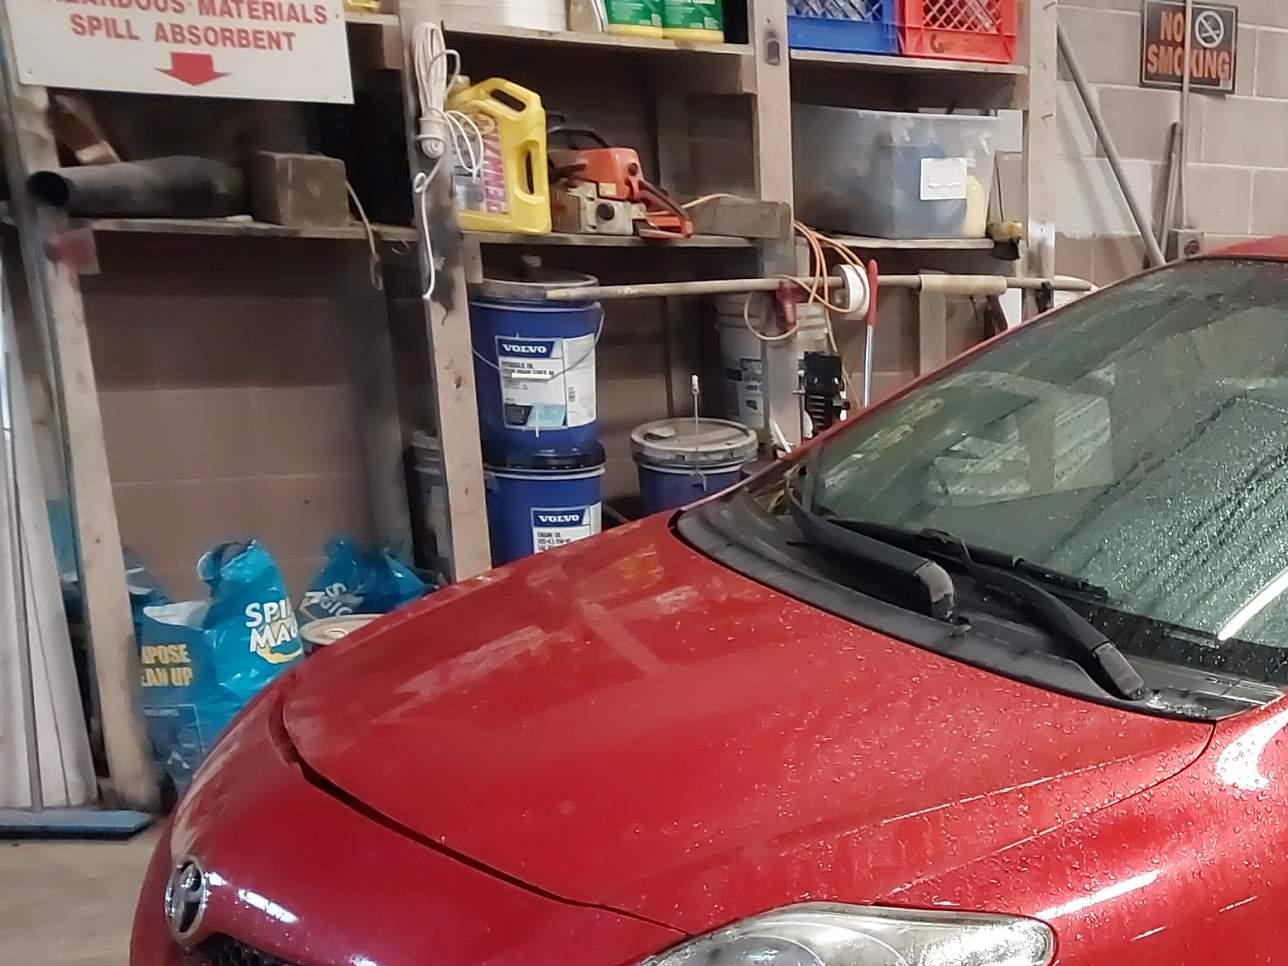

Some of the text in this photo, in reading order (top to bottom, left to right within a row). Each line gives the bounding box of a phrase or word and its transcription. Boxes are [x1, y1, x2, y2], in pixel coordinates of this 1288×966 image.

[198, 0, 328, 25] MATERIALS
[70, 13, 296, 51] SPILL ABSORBENT
[1160, 11, 1185, 42] NO
[502, 343, 547, 354] VOLVO
[537, 514, 580, 523] VOLVO
[170, 667, 192, 687] UP
